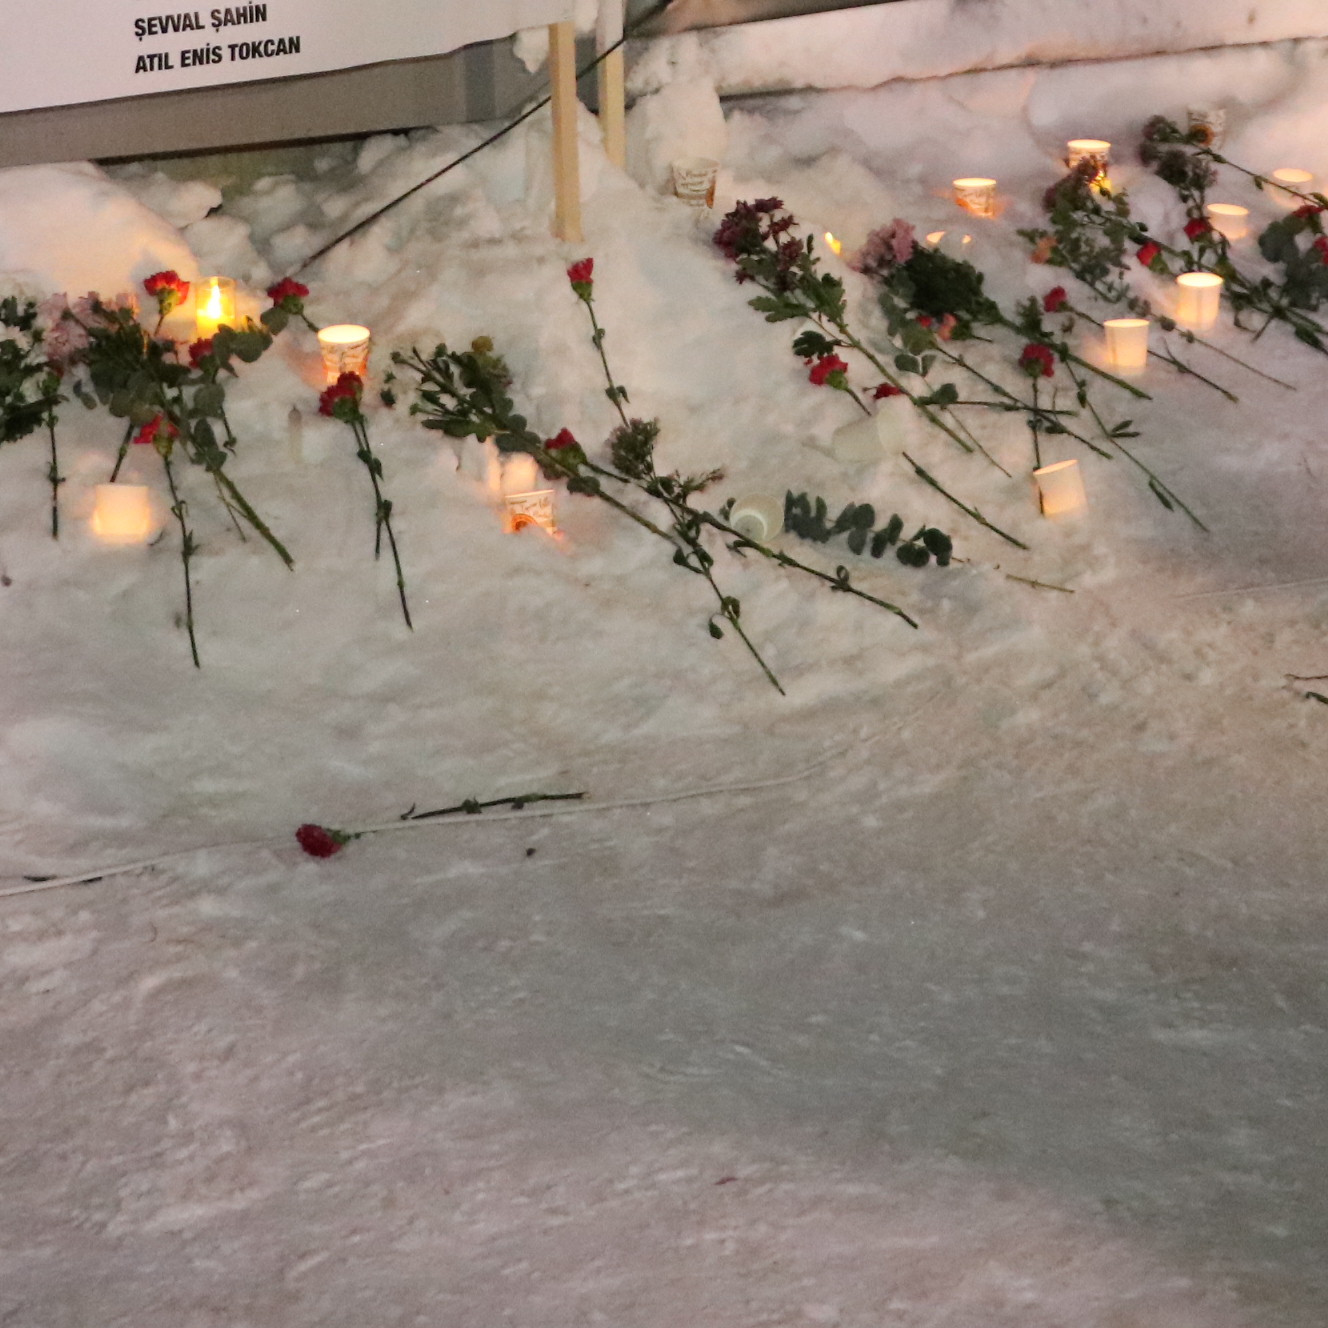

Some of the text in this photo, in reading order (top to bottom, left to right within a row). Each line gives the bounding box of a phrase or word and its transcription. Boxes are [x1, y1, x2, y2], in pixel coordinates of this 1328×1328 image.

[134, 1, 267, 41] ŞEVVAL ŞAHİN
[135, 36, 300, 74] ATIL ENİS TOKCAN
